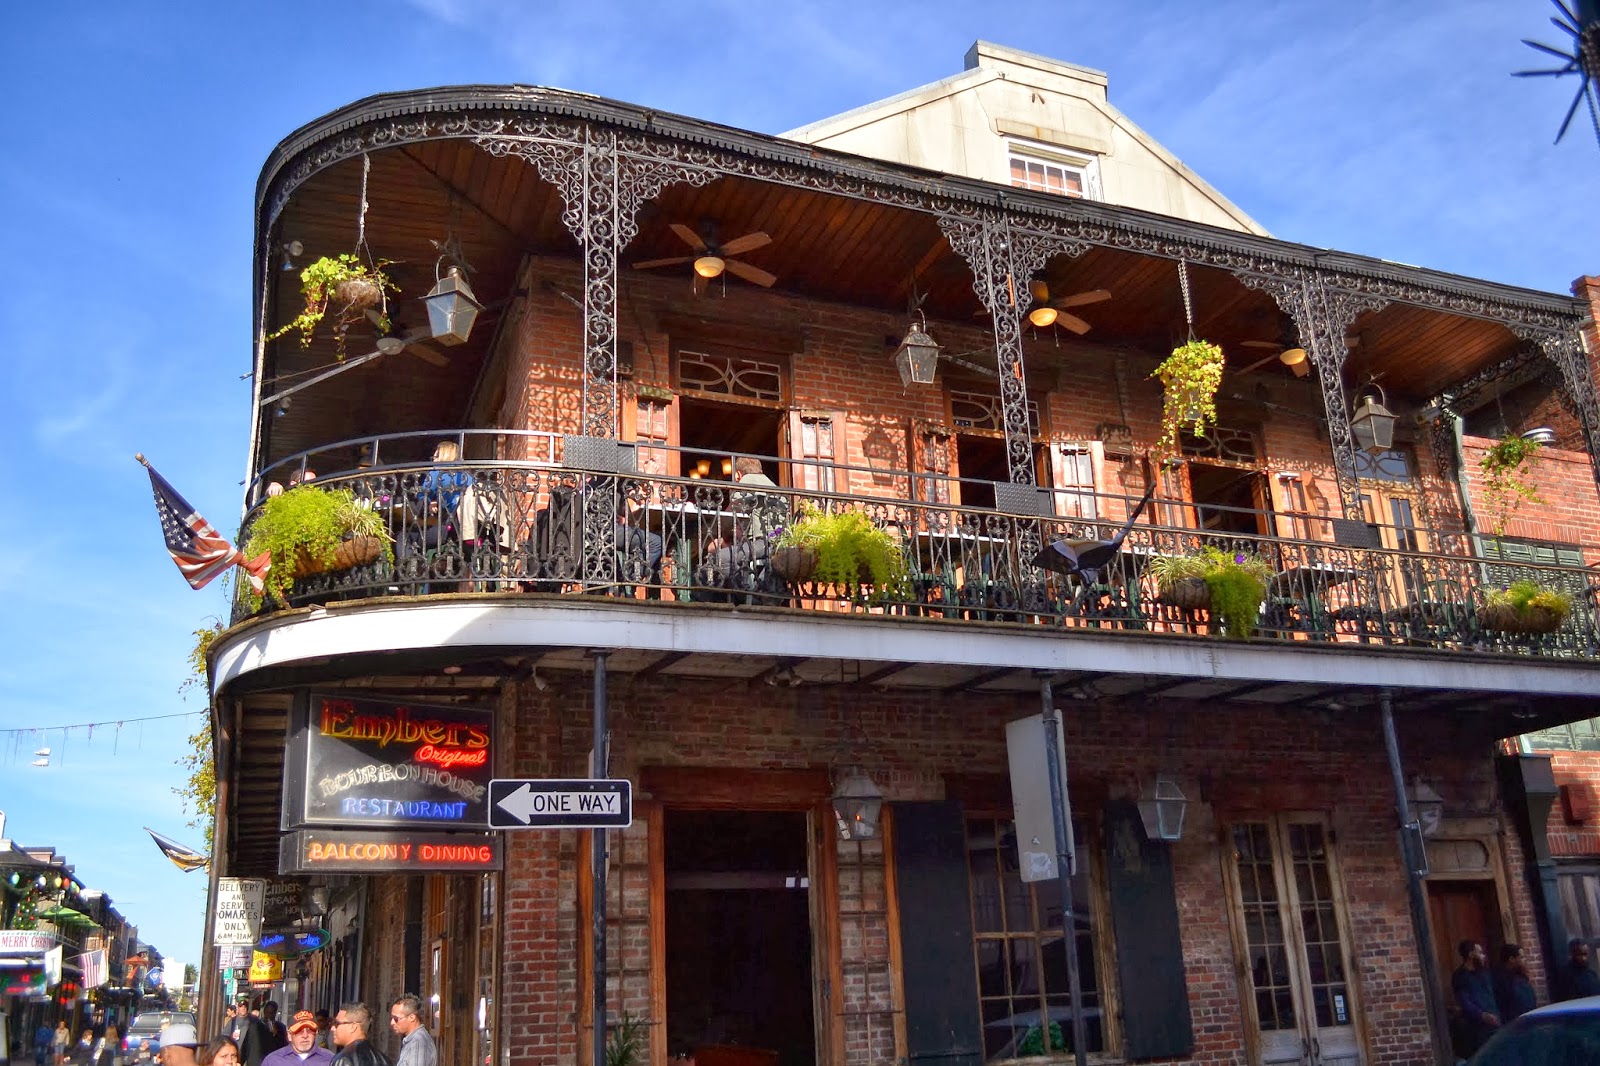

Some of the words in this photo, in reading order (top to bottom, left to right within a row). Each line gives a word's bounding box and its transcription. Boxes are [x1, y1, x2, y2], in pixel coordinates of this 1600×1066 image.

[318, 700, 490, 749] Embers
[418, 744, 486, 767] Original
[319, 763, 421, 798] BOURBON
[424, 768, 486, 801] HOUSE
[342, 797, 467, 819] RESTAURANT
[533, 795, 571, 812] ONE
[579, 794, 616, 812] WAY
[311, 844, 411, 861] BALCONY
[421, 846, 492, 862] DINING
[219, 883, 260, 892] DELIVERY
[231, 893, 246, 901] AND
[264, 895, 297, 906] STEAK
[220, 901, 256, 910] SERVICE
[224, 922, 247, 931] ONLY
[1, 936, 29, 947] MERRY
